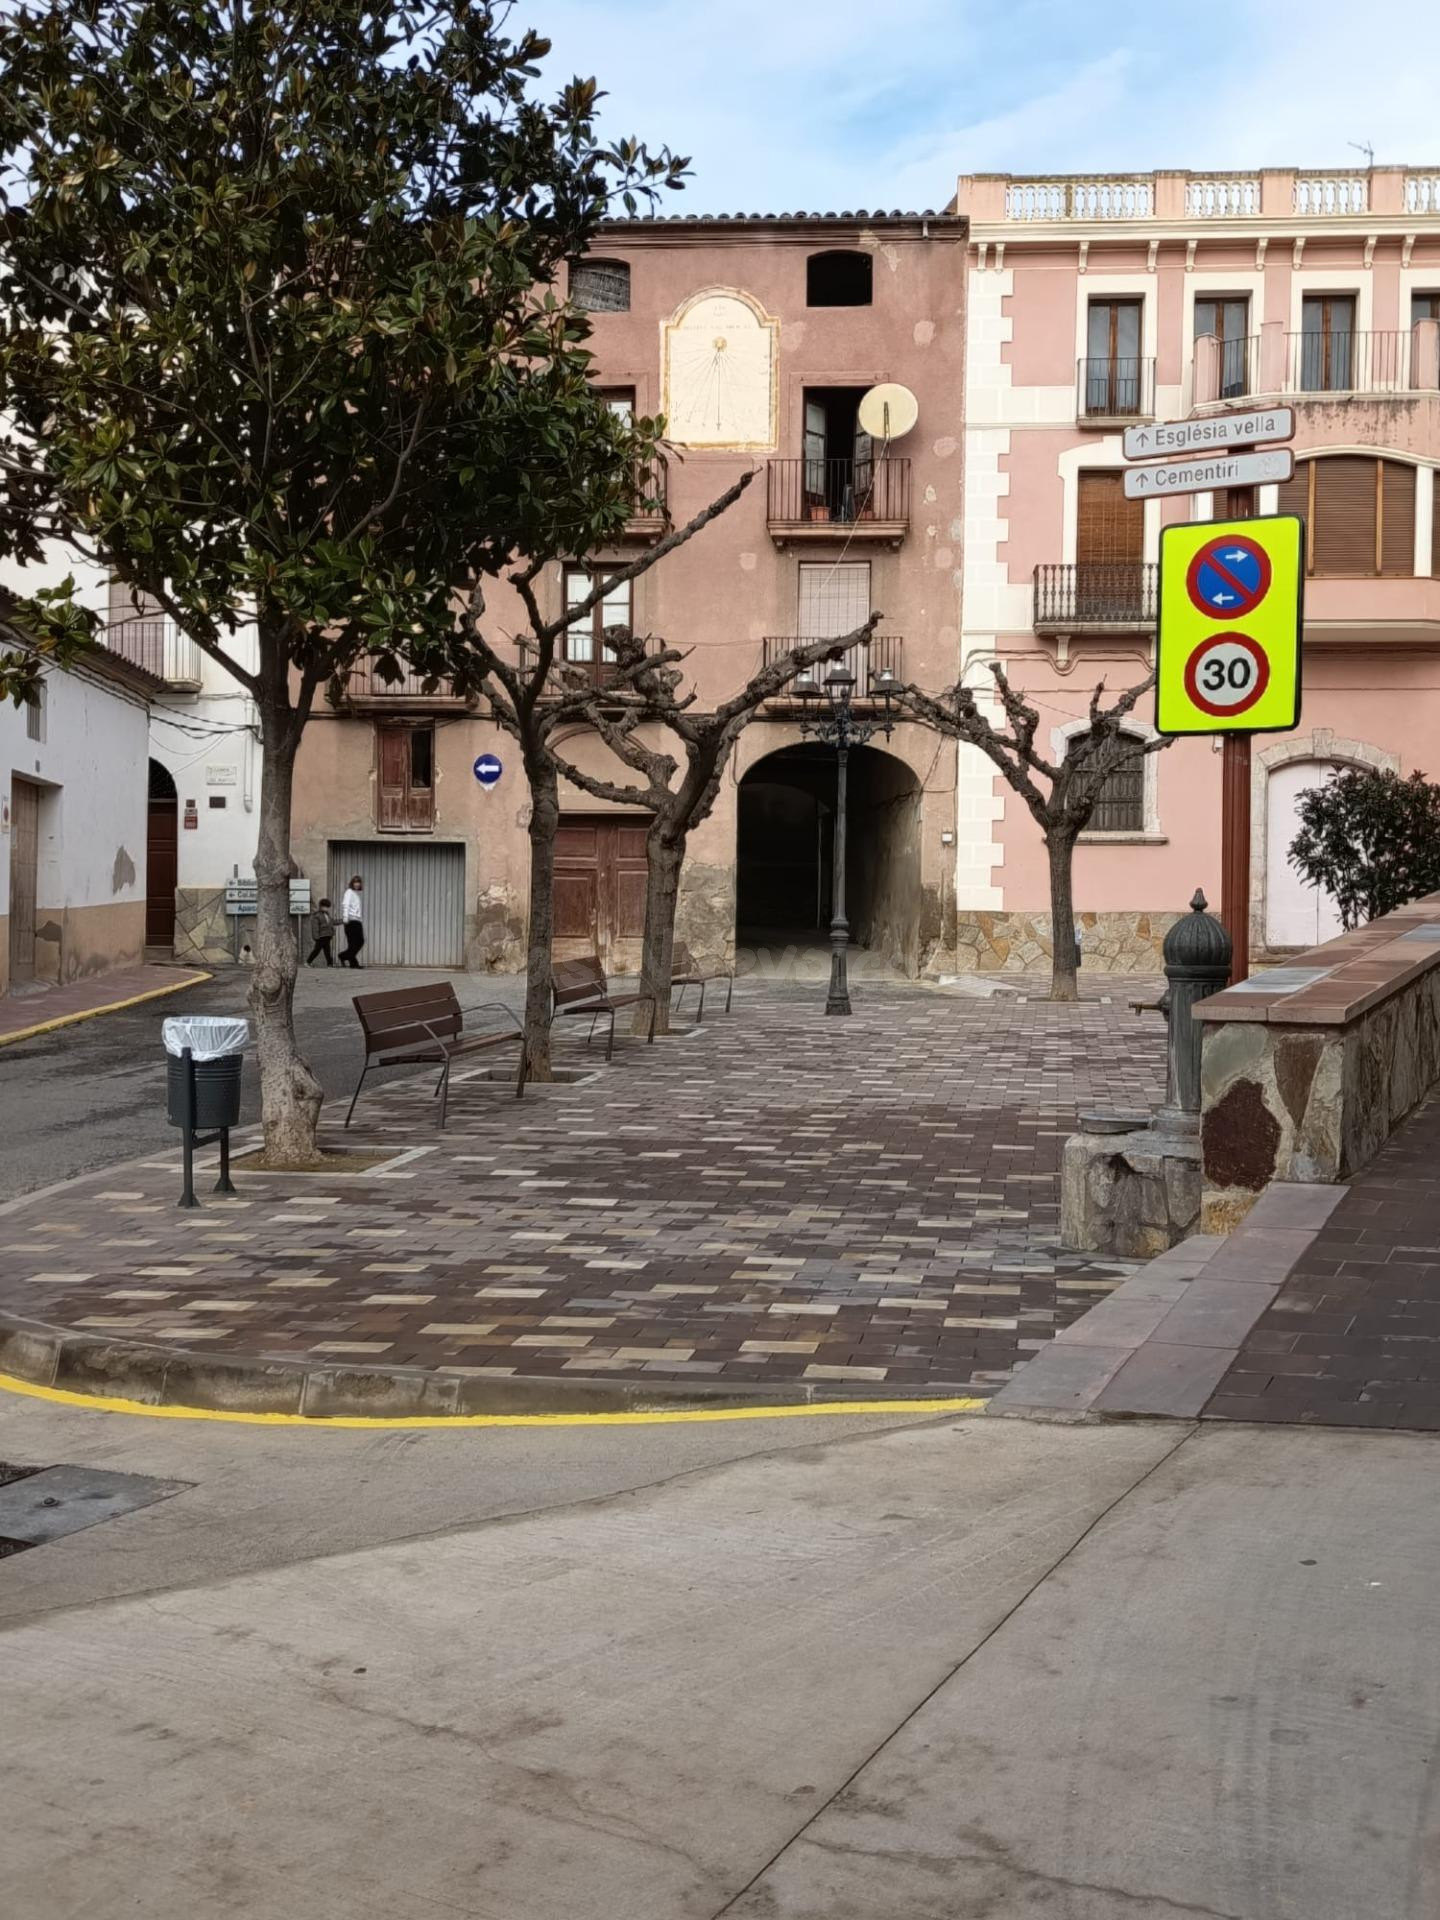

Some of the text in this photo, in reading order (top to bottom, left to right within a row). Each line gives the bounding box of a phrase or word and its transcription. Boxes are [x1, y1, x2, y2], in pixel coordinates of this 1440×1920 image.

[1155, 416, 1275, 447] Església vella
[1155, 461, 1239, 486] Cementiri
[1203, 657, 1250, 690] 30
